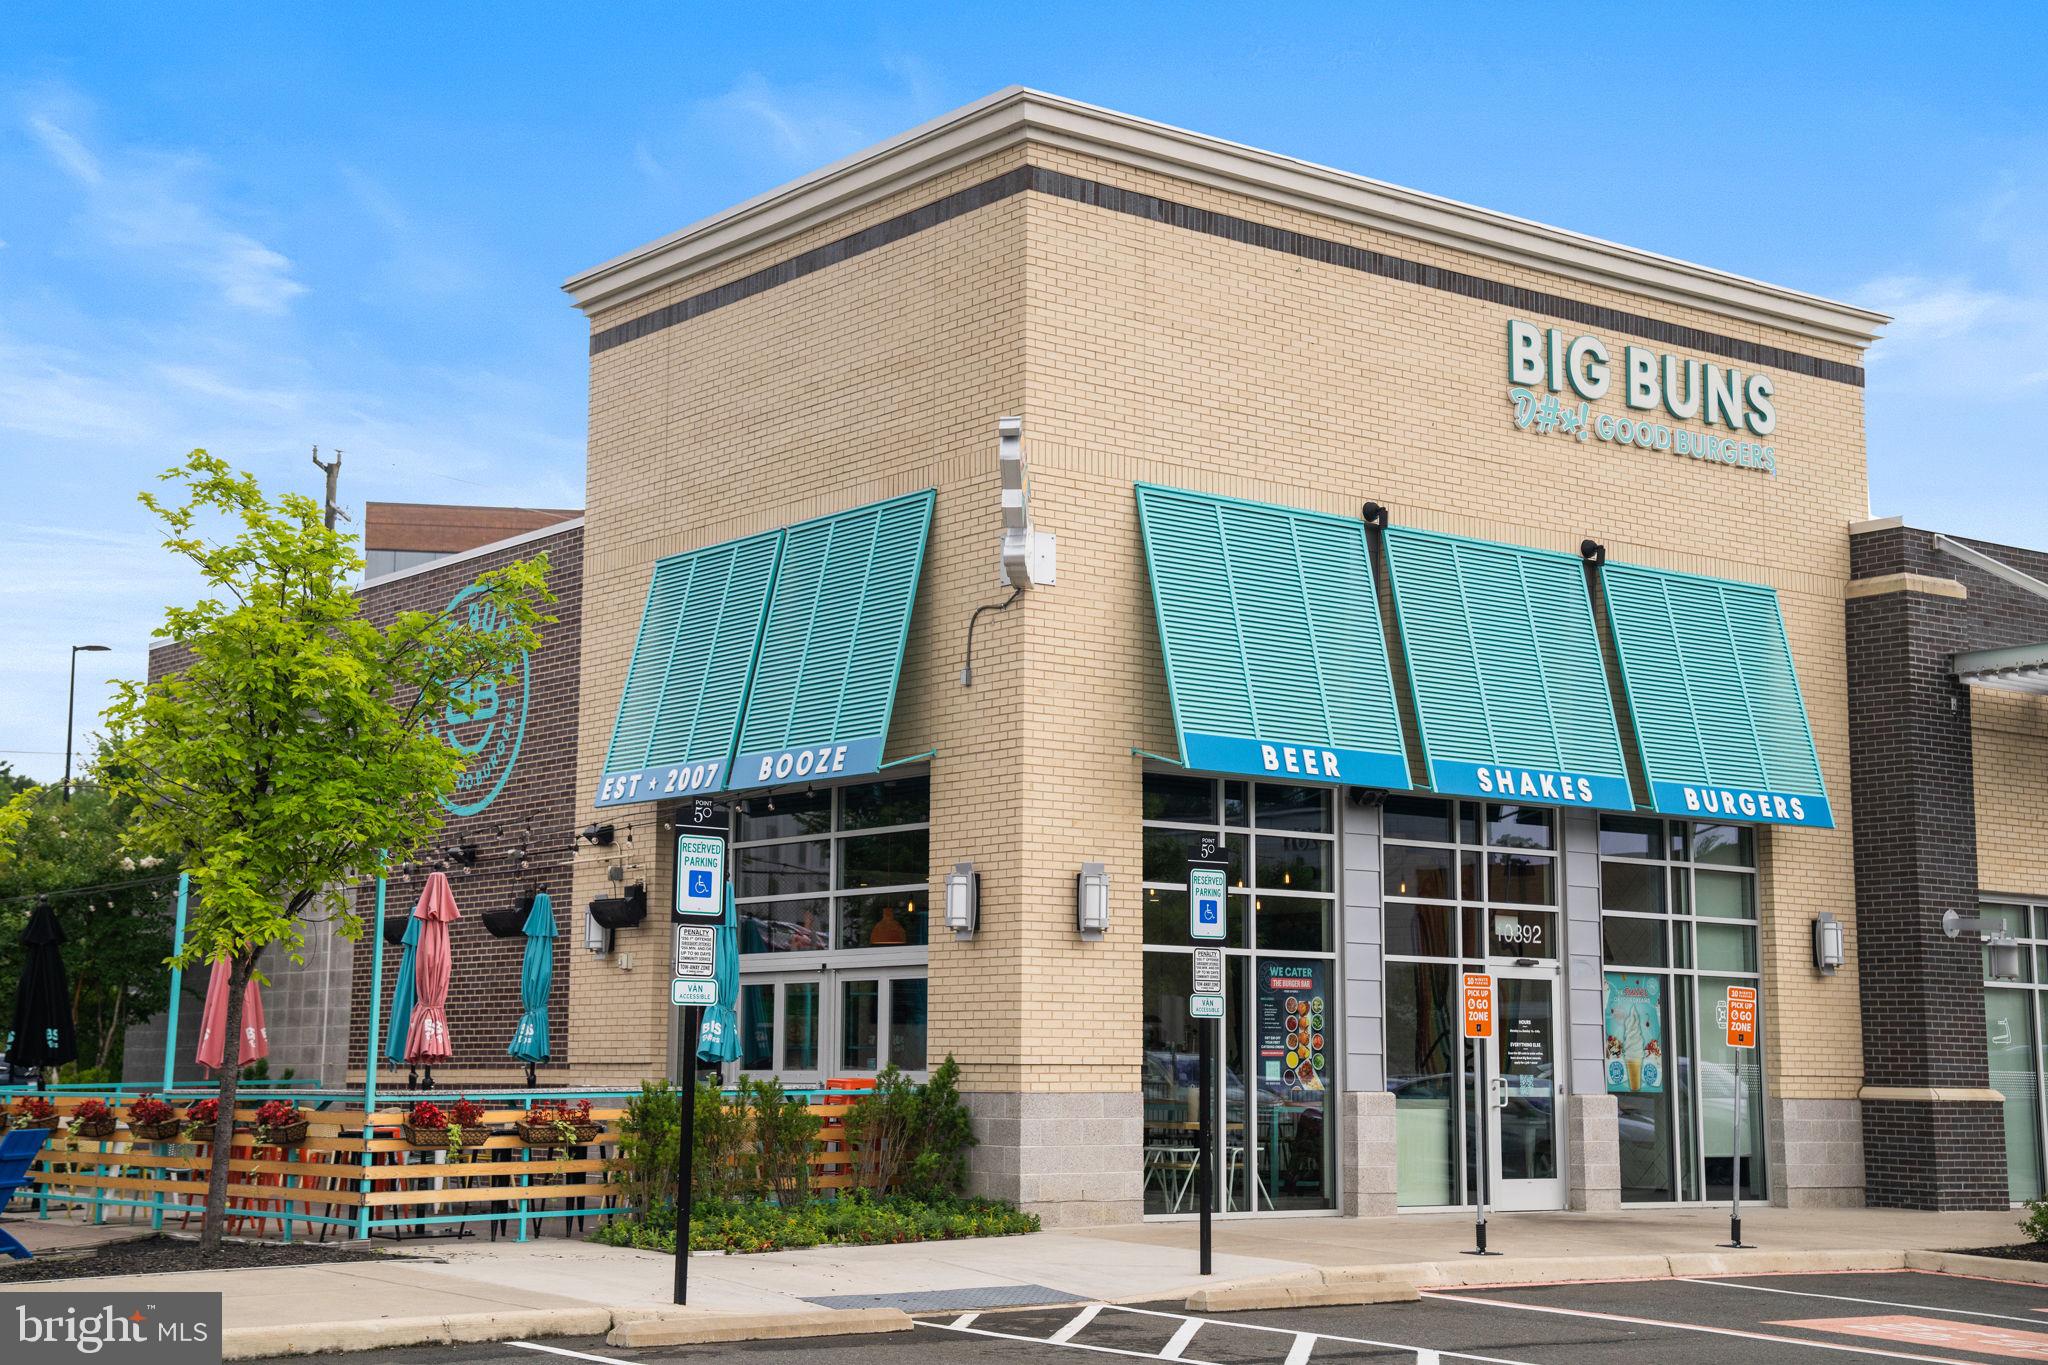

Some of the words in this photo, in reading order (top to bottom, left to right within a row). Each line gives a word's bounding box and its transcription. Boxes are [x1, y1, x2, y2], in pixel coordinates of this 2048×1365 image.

[1507, 319, 1611, 400] BIG
[1625, 345, 1777, 436] BUNS
[1595, 414, 1671, 451] GOOD
[1673, 429, 1777, 471] BURGERS
[758, 746, 848, 781] BOOZE
[1261, 744, 1341, 777] BEER
[601, 774, 643, 801] EST
[664, 763, 719, 793] 2007
[1476, 767, 1593, 802] SHAKES
[1683, 787, 1805, 820] BURGERS
[694, 807, 712, 823] 50
[682, 842, 721, 855] RESERVED
[1201, 844, 1215, 859] 50
[684, 857, 718, 868] PARKING
[1193, 875, 1223, 886] RESERVED
[1195, 887, 1221, 897] PARKING
[1269, 966, 1284, 976] WE
[1284, 967, 1313, 977] CATER
[687, 985, 704, 993] VAN
[1476, 999, 1489, 1009] GO
[1731, 1001, 1744, 1009] PICK
[1468, 1011, 1489, 1021] ZONE
[1740, 1011, 1752, 1021] GO
[1730, 1021, 1752, 1032] ZONE
